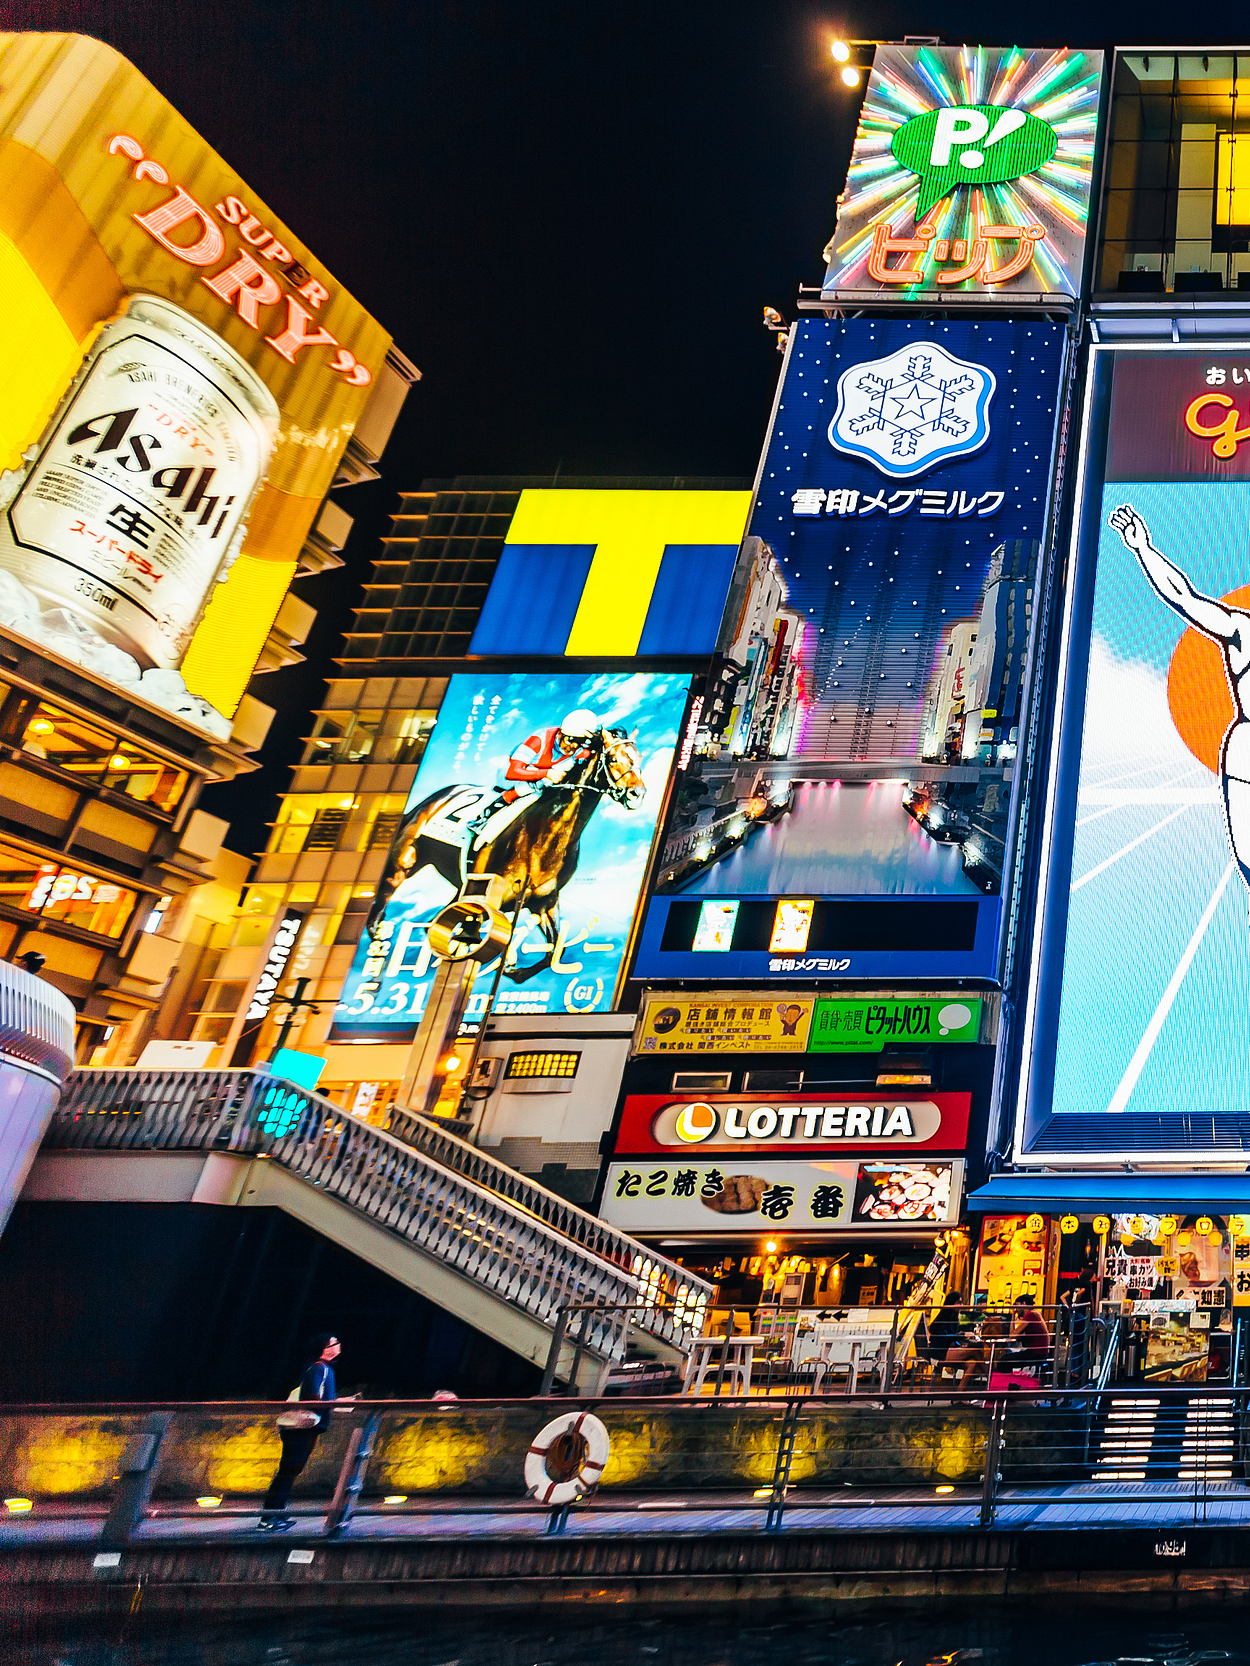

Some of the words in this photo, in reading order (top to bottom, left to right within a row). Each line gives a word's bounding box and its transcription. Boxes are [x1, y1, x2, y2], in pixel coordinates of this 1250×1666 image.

[216, 195, 330, 308] SUPER
[866, 222, 1046, 287] ピップ
[66, 408, 236, 539] Asahi
[791, 488, 1006, 518] 雪印メグミルク
[105, 503, 157, 550] 生
[69, 520, 165, 583] スーパードライ
[73, 577, 119, 611] 350ml
[245, 918, 302, 1020] TSUTAYA
[768, 957, 851, 972] 雪印メグミルク
[347, 982, 428, 1015] 5.31
[686, 1008, 772, 1021] 店舗情報館
[818, 1010, 864, 1031] 賃貸・売買
[865, 1005, 931, 1035] ピタットハウス
[659, 1042, 693, 1050] 株式会社
[698, 1042, 750, 1050] 関西インベスト
[724, 1105, 913, 1138] LOTTERIA
[616, 1168, 726, 1198] たこ焼き
[760, 1184, 845, 1220] 壱番
[1129, 1264, 1154, 1276] 串カツ
